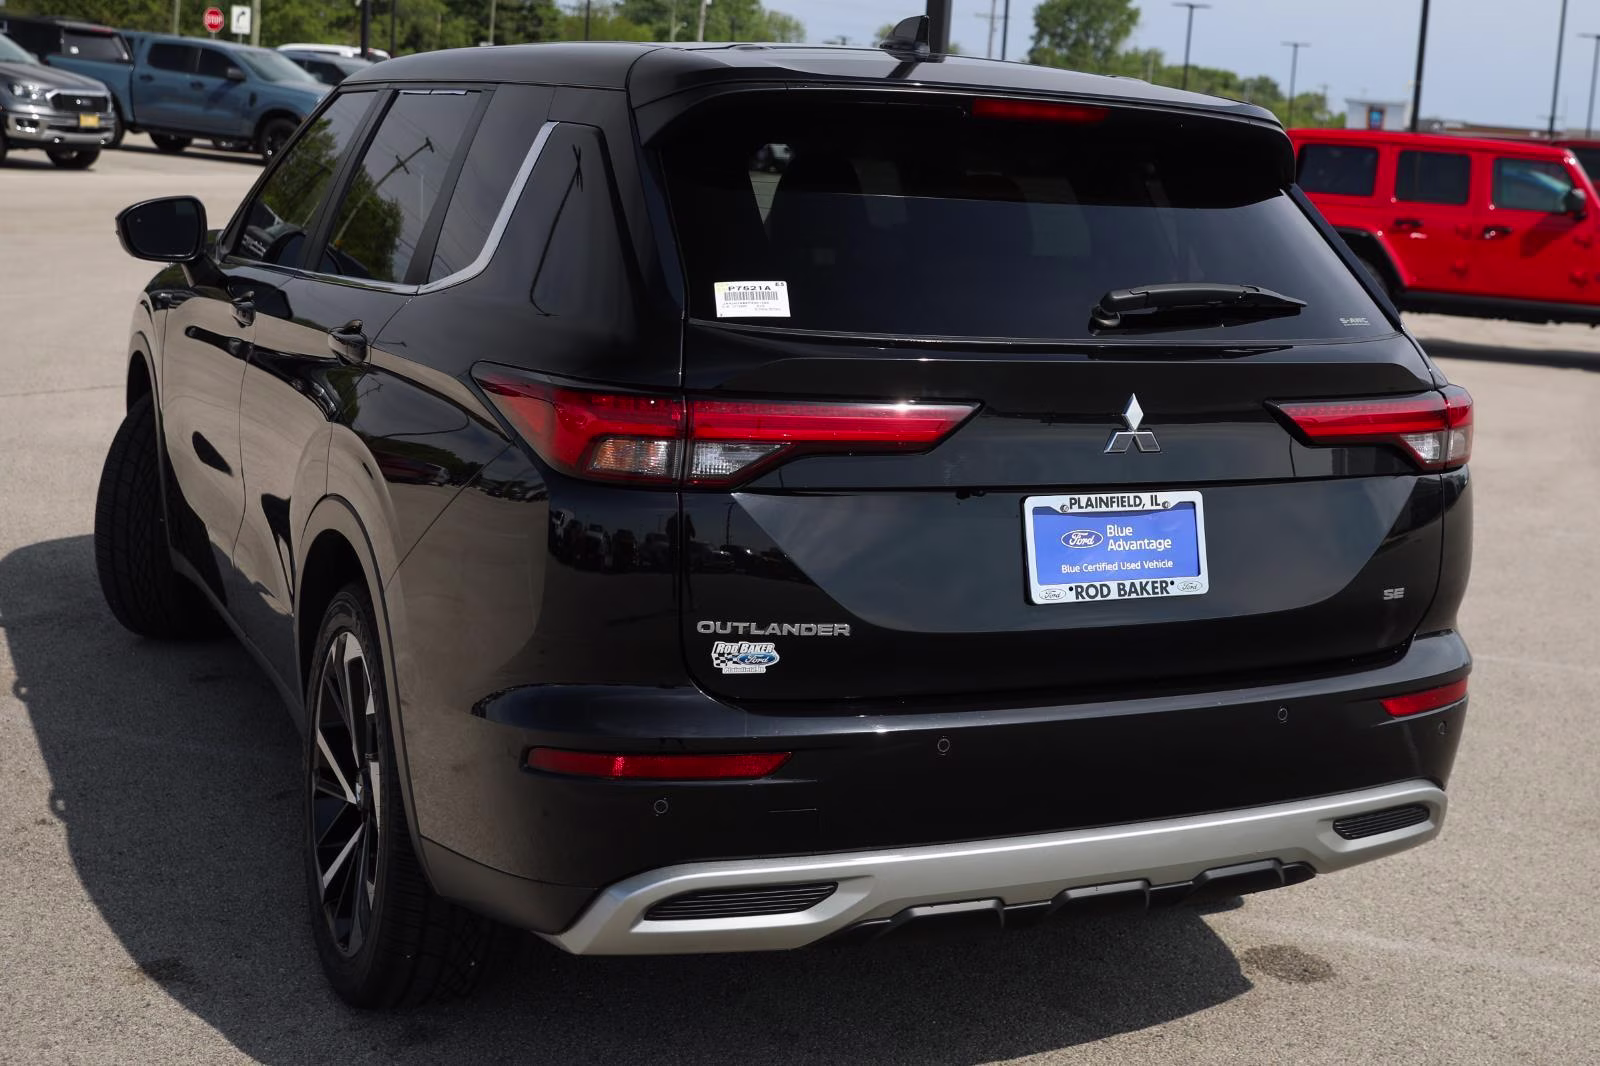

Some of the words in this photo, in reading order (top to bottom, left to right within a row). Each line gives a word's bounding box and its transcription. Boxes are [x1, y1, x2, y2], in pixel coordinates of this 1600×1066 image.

[1069, 495, 1146, 510] PLAINFIELD,
[1150, 494, 1161, 507] IL
[1106, 524, 1133, 537] Blue
[1069, 532, 1095, 546] Ford
[1107, 538, 1172, 552] Advantage
[1061, 564, 1081, 574] Blue
[1082, 562, 1119, 573] Certified
[1120, 561, 1141, 571] Used
[1144, 559, 1173, 569] Vehicle
[1074, 584, 1111, 600] ROD
[1117, 580, 1171, 598] BAKER
[1383, 587, 1405, 600] SE
[696, 620, 851, 636] OUTLANDER
[740, 642, 774, 654] BAKER
[745, 654, 770, 664] Ford
